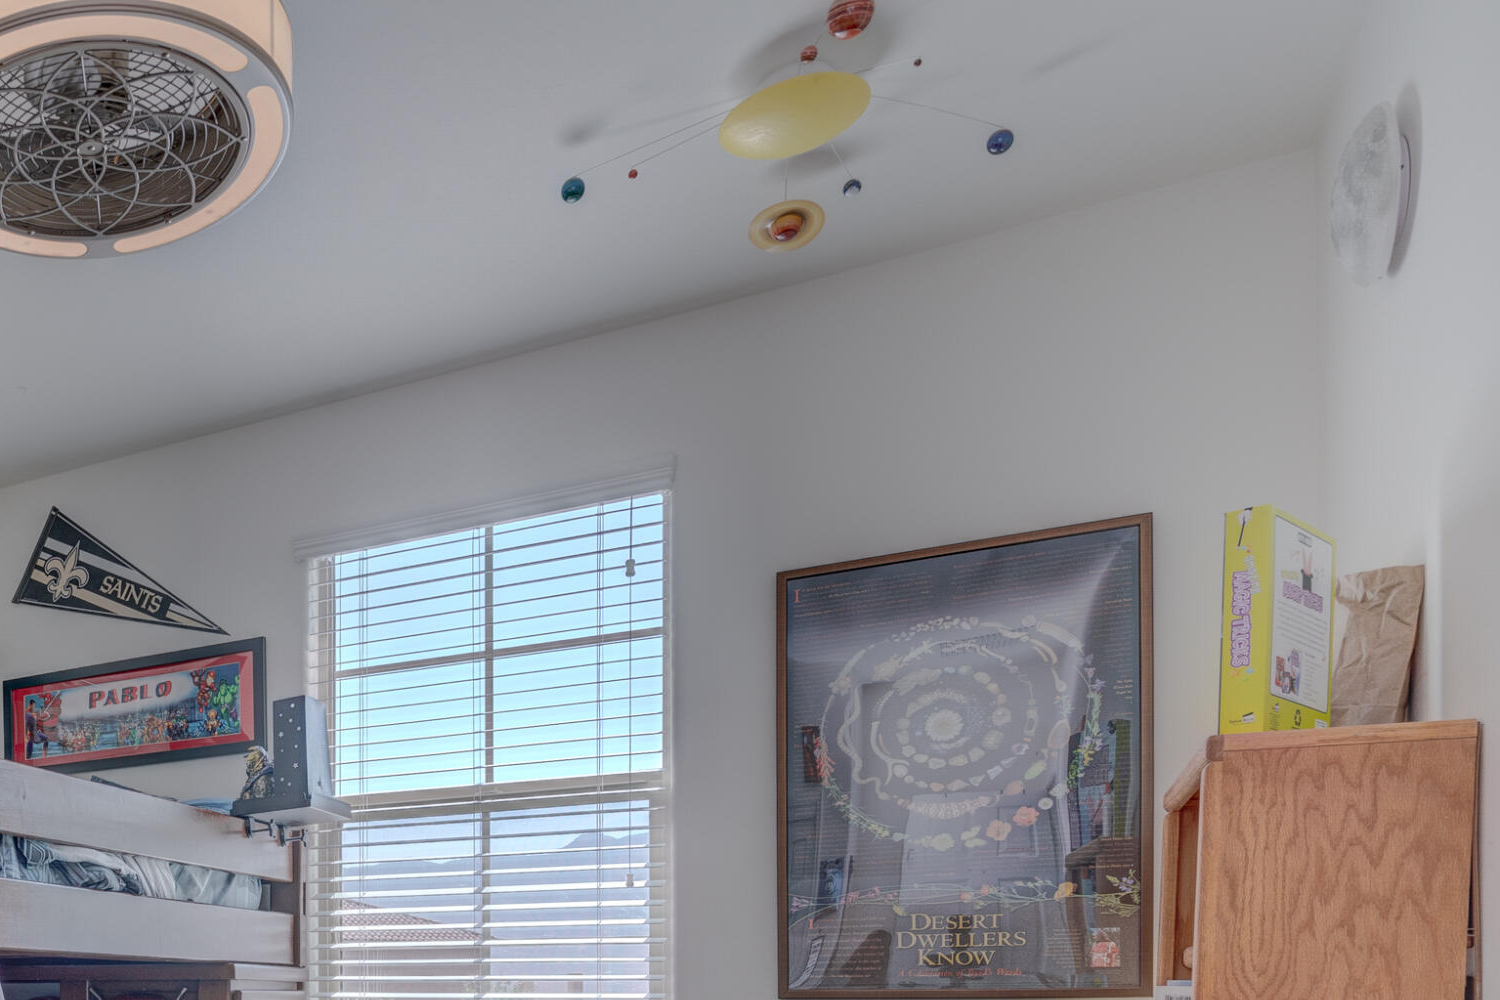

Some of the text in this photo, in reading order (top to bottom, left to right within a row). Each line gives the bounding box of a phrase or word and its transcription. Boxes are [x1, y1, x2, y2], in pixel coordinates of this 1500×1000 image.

[100, 575, 163, 613] SAINTS
[1230, 614, 1251, 668] TRICKS
[88, 680, 173, 709] PABLO
[910, 913, 1004, 931] DESERT
[896, 931, 1027, 949] DWELLERS
[917, 948, 996, 966] KNOW
